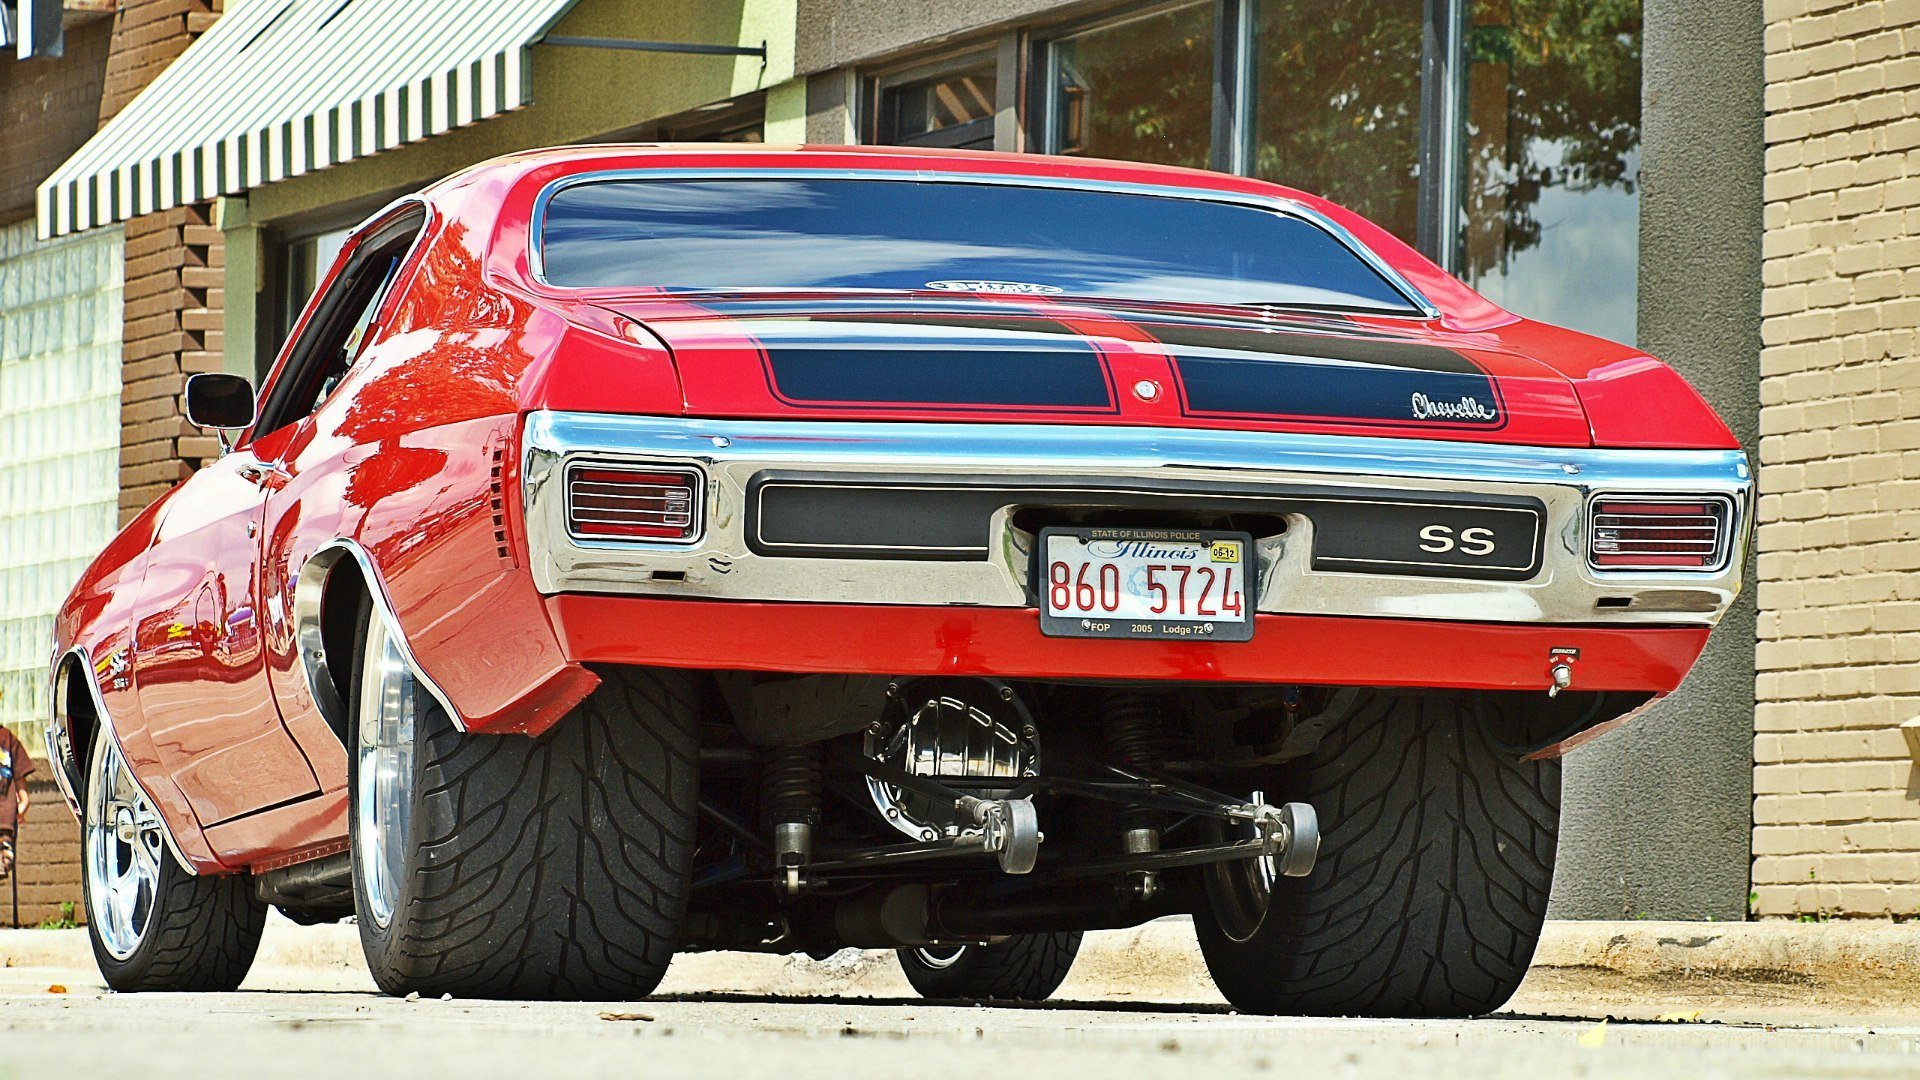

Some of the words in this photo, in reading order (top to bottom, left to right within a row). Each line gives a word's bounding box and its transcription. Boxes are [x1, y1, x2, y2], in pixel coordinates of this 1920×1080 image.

[1411, 392, 1496, 419] Chevelle
[1091, 530, 1118, 538] STATE
[1119, 530, 1132, 538] OF
[1133, 531, 1168, 539] ILLINOIS
[1170, 532, 1200, 540] POLICE
[1419, 525, 1495, 556] SS
[1087, 540, 1198, 560] Illinois
[1051, 561, 1119, 612] 860
[1147, 564, 1241, 617] 5724
[1091, 623, 1111, 632] FOP
[1131, 624, 1153, 633] 2005
[1163, 625, 1191, 636] Lodge
[1193, 626, 1204, 634] 72
